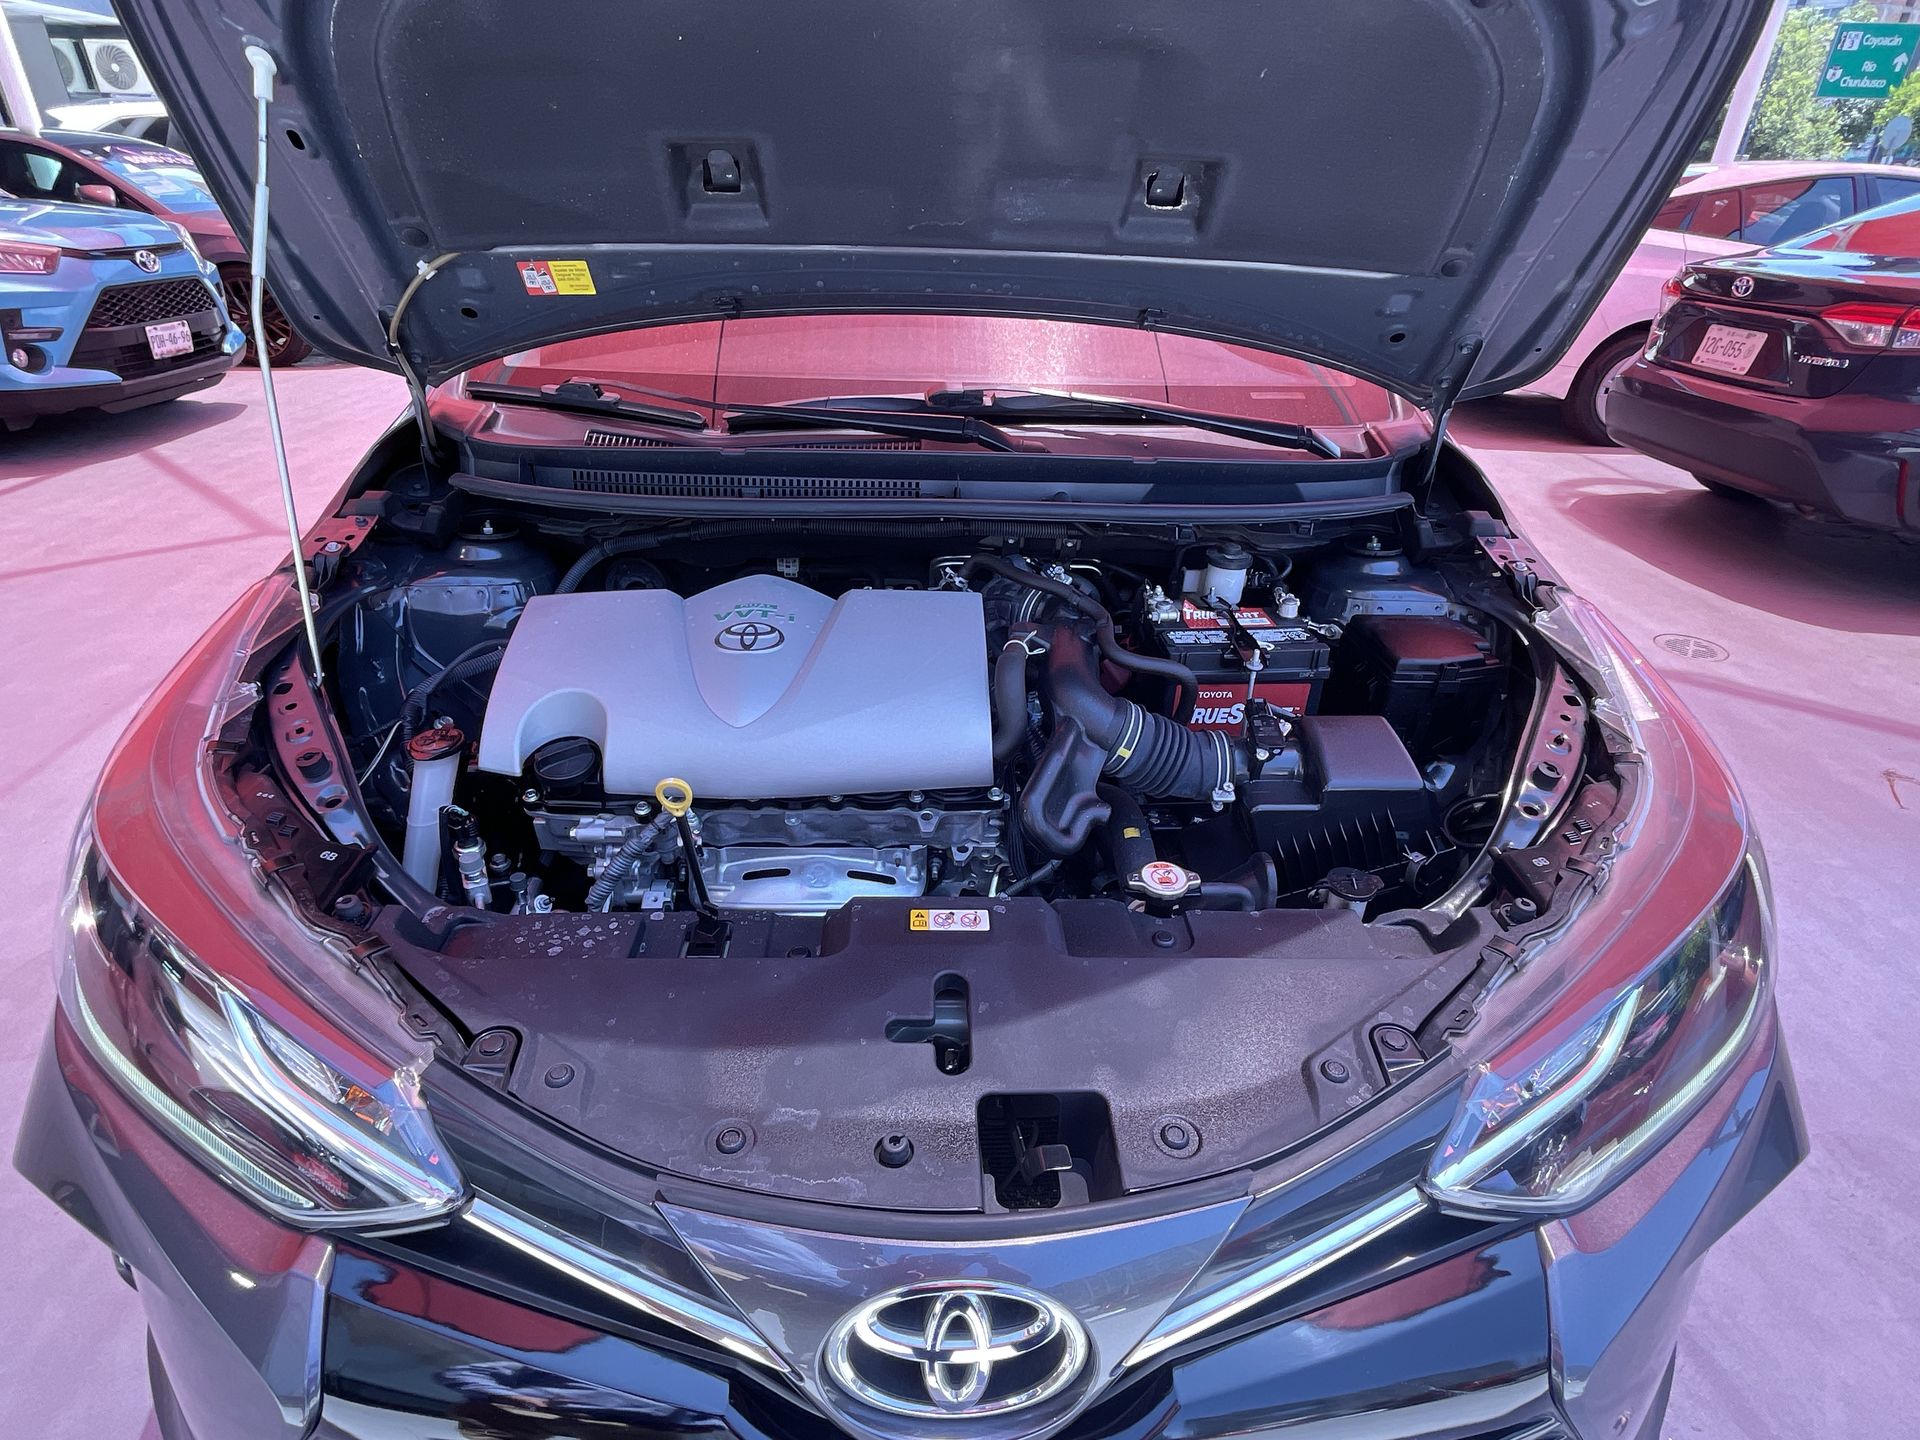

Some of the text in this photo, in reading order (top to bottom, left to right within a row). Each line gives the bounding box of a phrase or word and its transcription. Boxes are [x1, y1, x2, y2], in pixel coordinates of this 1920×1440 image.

[1863, 34, 1903, 49] Coyoacán
[1840, 76, 1887, 88] Churubusco
[1701, 336, 1746, 358] 12G-055
[714, 609, 796, 622] VVT-i
[1198, 691, 1233, 699] TOYOTA
